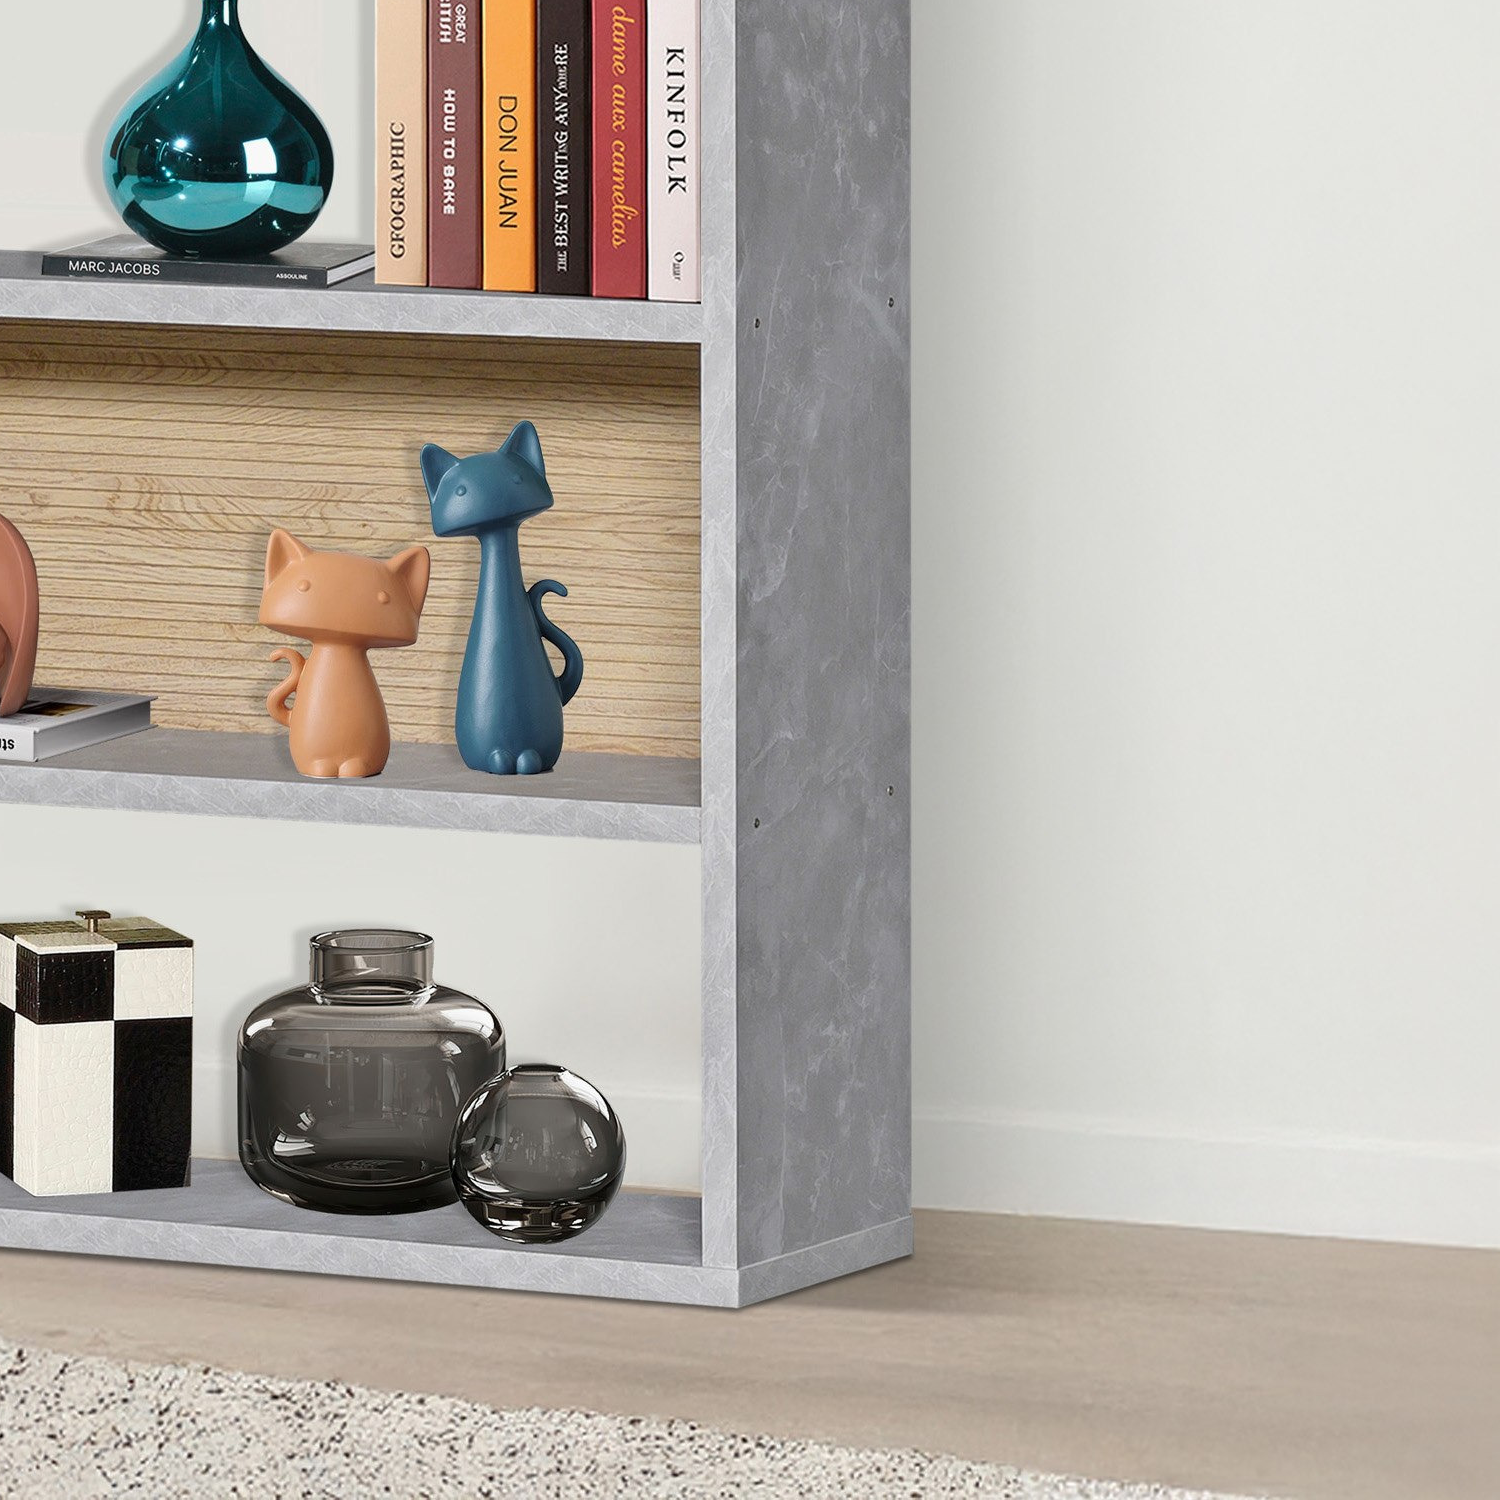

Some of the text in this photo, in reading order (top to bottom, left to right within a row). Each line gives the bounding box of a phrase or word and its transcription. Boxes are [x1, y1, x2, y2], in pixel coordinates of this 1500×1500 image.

[455, 3, 466, 43] GREAT
[612, 4, 636, 77] dame
[612, 84, 625, 132] aux
[666, 46, 687, 195] KINFOLK
[443, 88, 456, 215] HOW TO BAKE
[499, 96, 518, 229] DON JUAN
[612, 139, 639, 249] camelias
[554, 200, 568, 247] BEST
[68, 260, 160, 276] MARC JACOBS
[276, 272, 308, 280] ASSOULINE
[557, 250, 567, 271] THE
